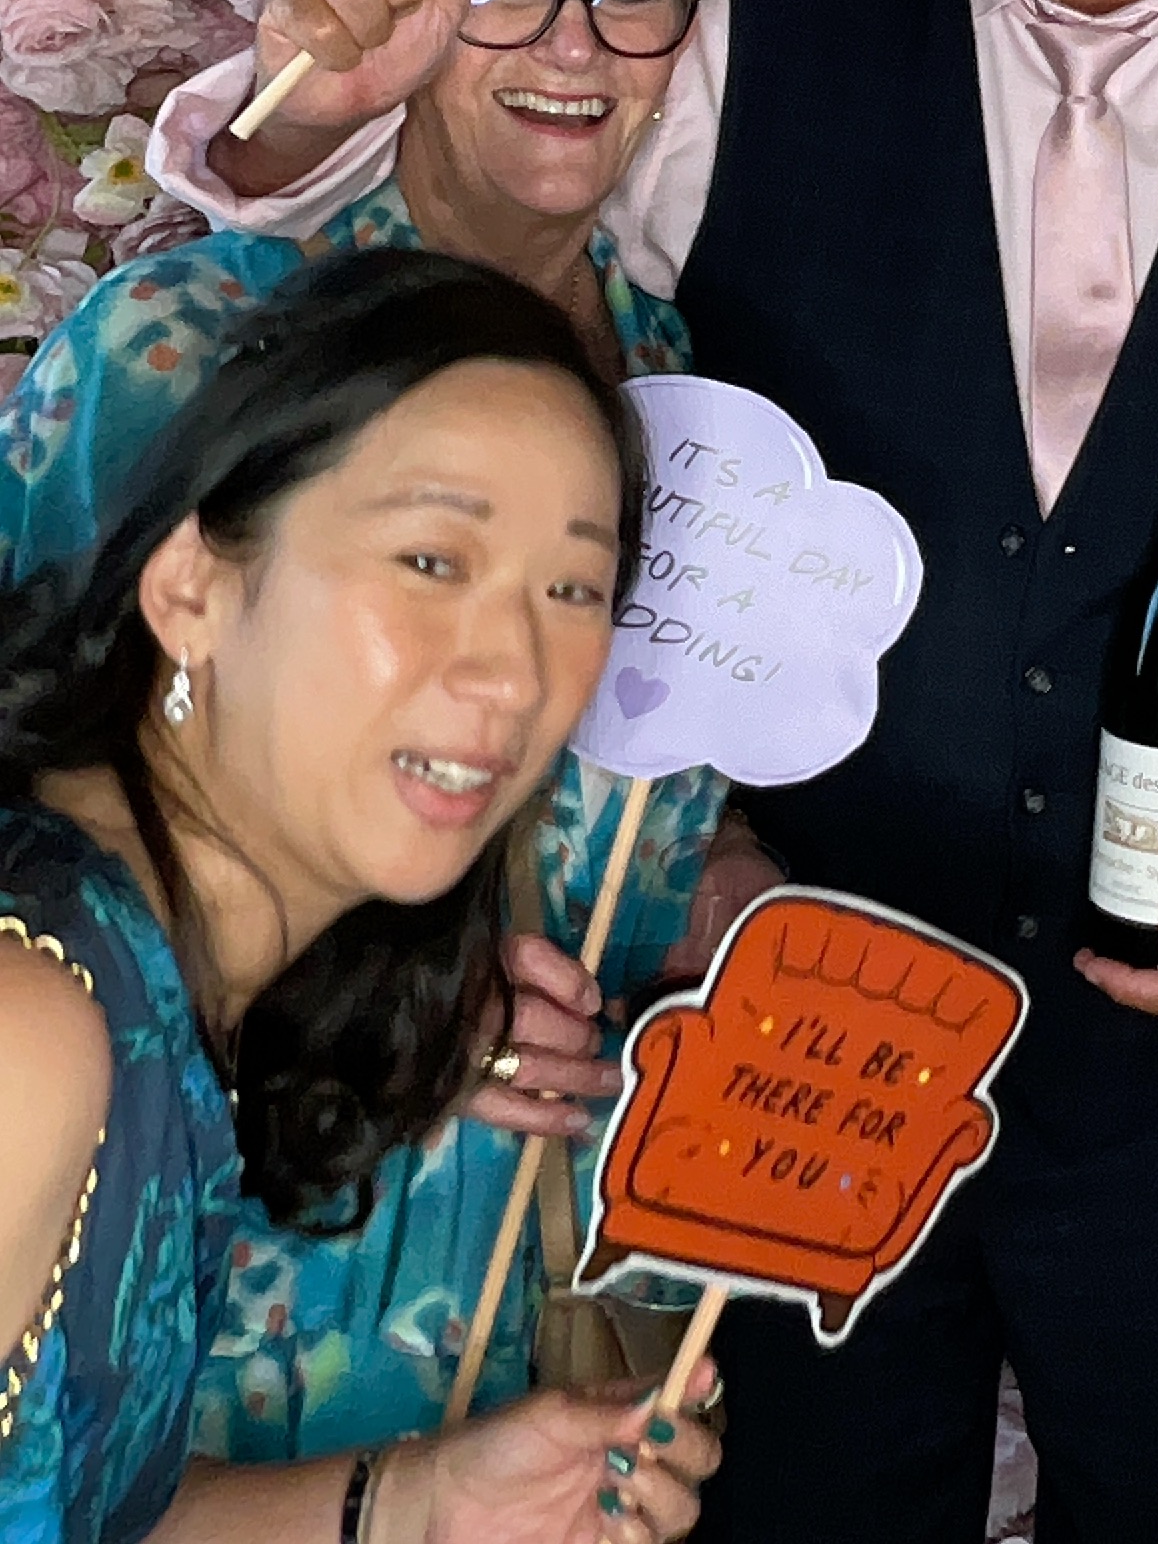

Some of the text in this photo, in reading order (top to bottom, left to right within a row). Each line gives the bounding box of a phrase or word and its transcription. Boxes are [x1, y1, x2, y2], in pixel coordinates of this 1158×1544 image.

[669, 438, 793, 506] ITS A
[645, 484, 874, 596] UTIFUL DAY
[716, 589, 756, 613] A
[612, 603, 782, 682] DDING!
[780, 1016, 915, 1086] I'LL BE
[722, 1062, 906, 1148] THERE FOR
[742, 1136, 830, 1190] YOU
